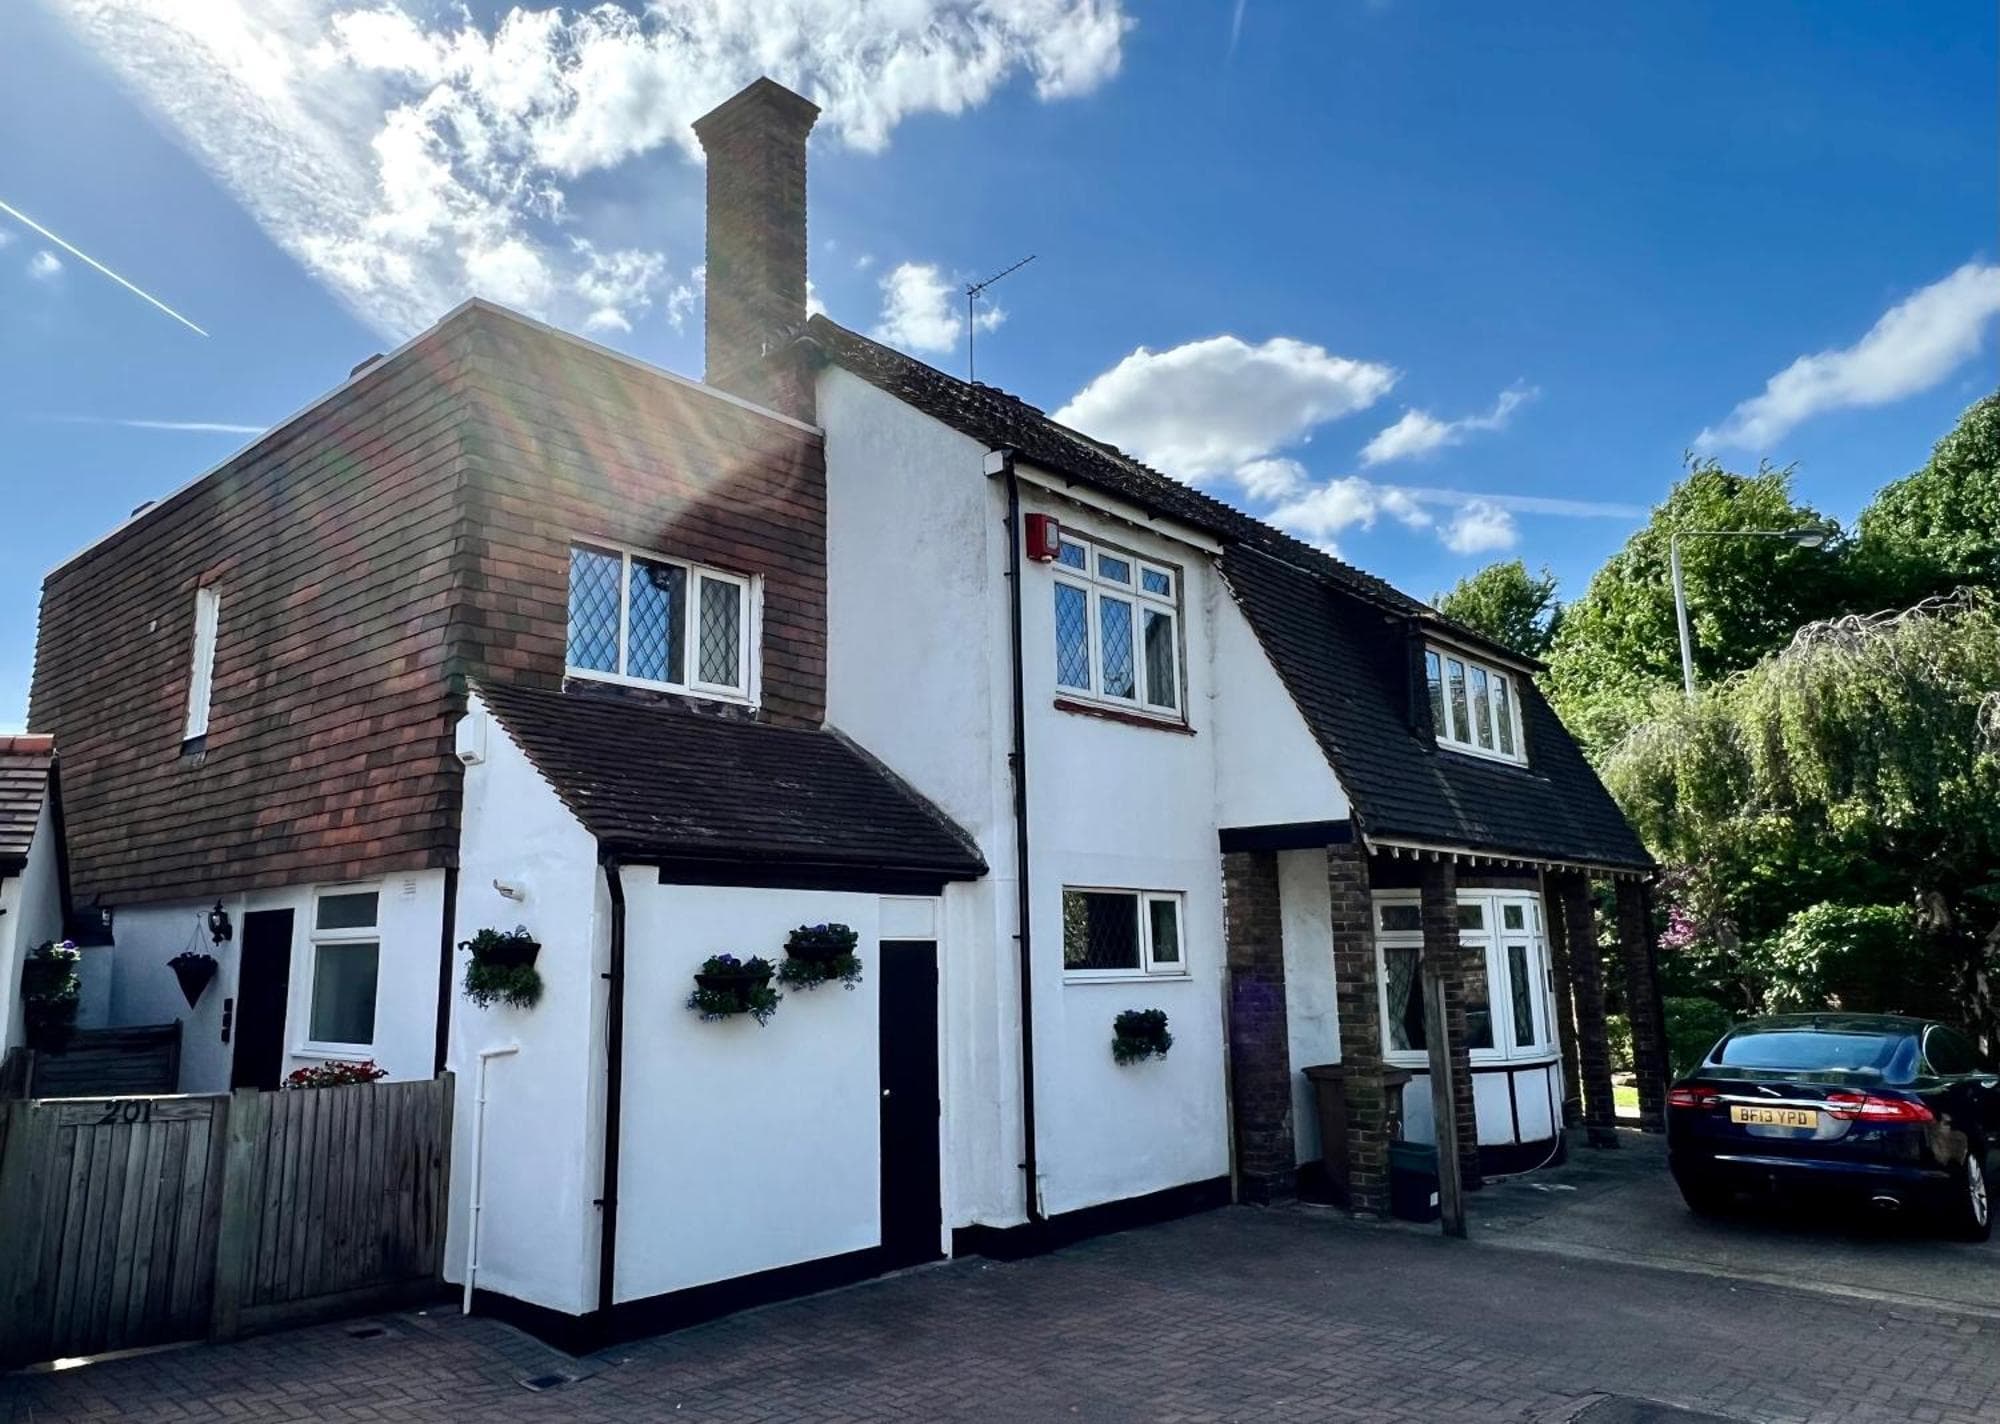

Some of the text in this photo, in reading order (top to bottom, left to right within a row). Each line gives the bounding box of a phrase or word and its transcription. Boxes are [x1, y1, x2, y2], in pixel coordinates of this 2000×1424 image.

[97, 1101, 151, 1124] 201
[1740, 1108, 1808, 1125] BF13 YPD
